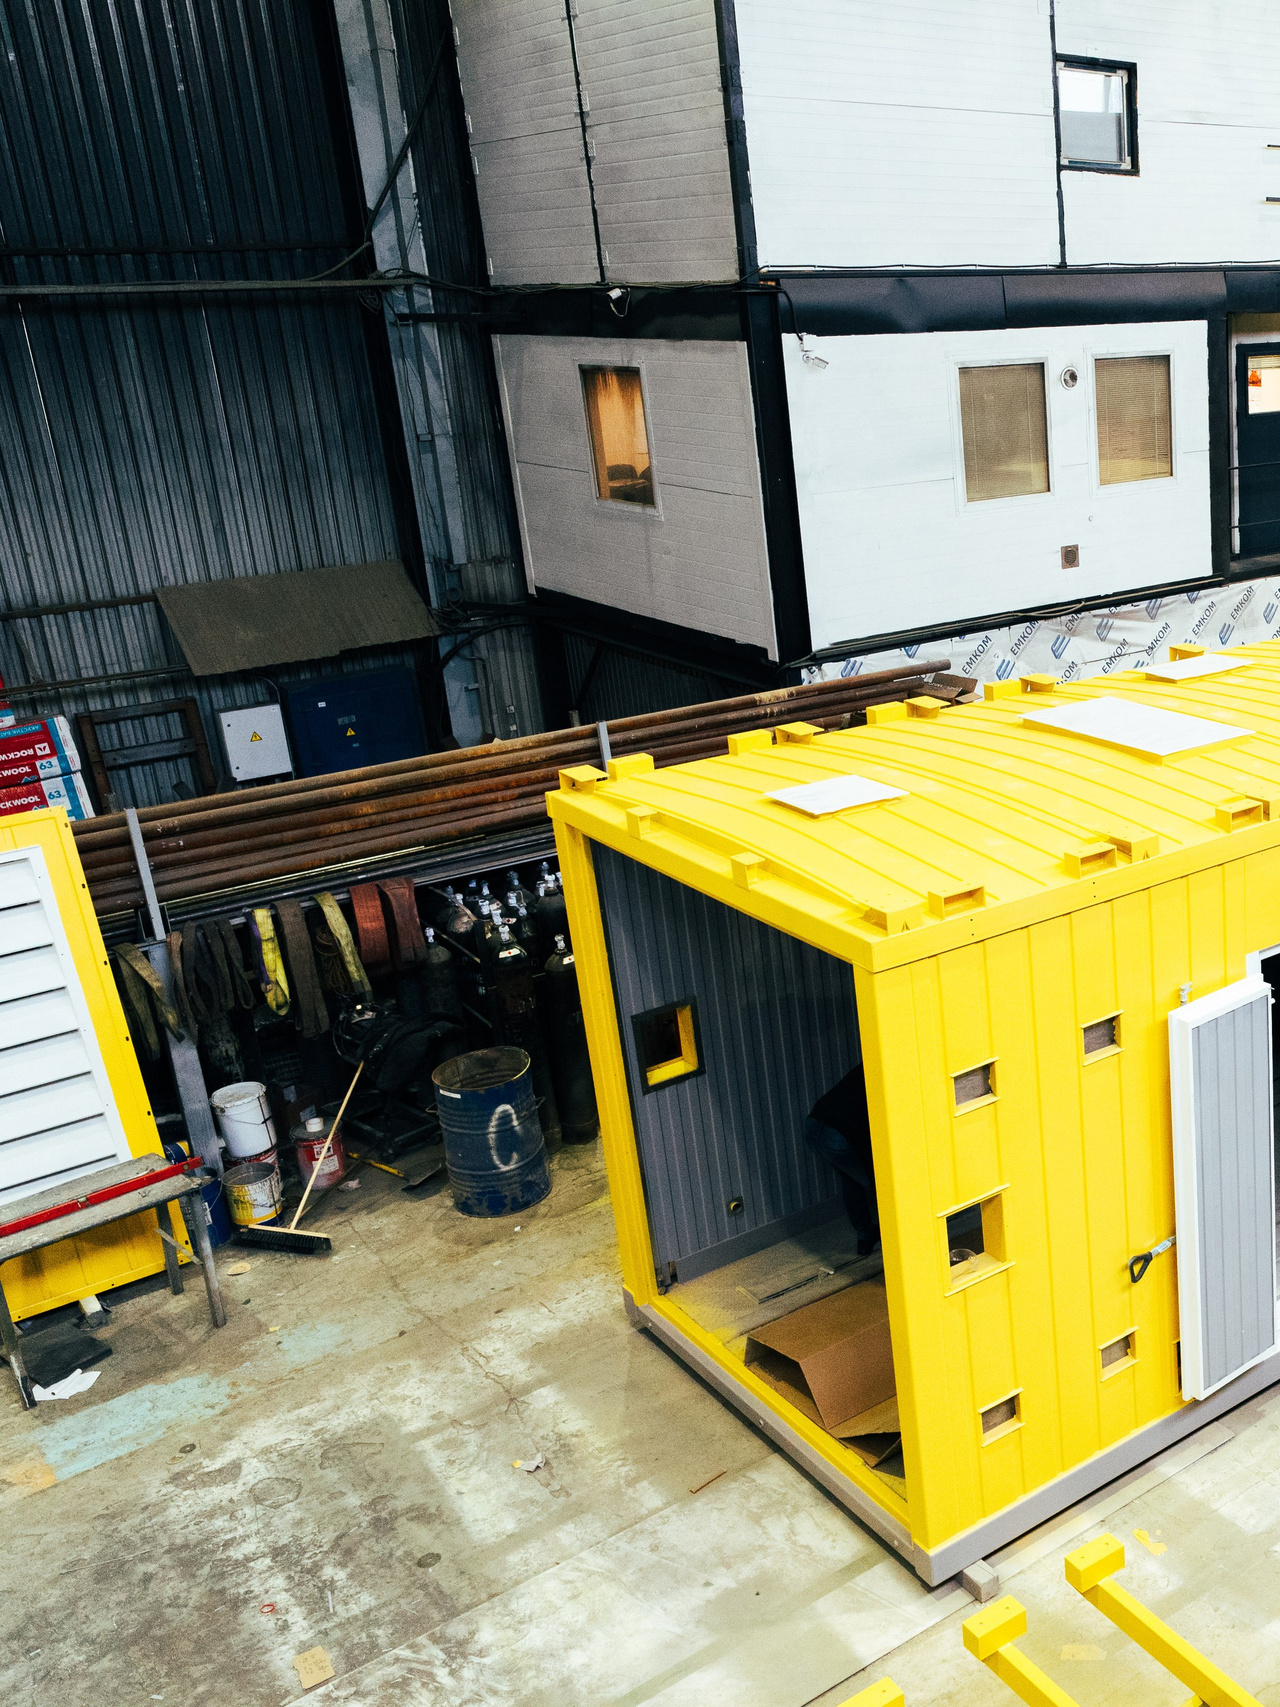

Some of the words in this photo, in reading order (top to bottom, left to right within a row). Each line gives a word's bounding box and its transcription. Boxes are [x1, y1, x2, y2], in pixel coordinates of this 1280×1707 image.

[1191, 600, 1217, 637] EMKOM
[1230, 585, 1255, 621] EMKOM
[961, 634, 992, 675] EMKOM
[1010, 620, 1040, 657] EMKOM
[1101, 638, 1129, 675] EMKOM
[1145, 621, 1171, 657] EMKOM
[0, 765, 32, 778] WOOL
[39, 760, 53, 771] 63
[48, 790, 62, 800] 63
